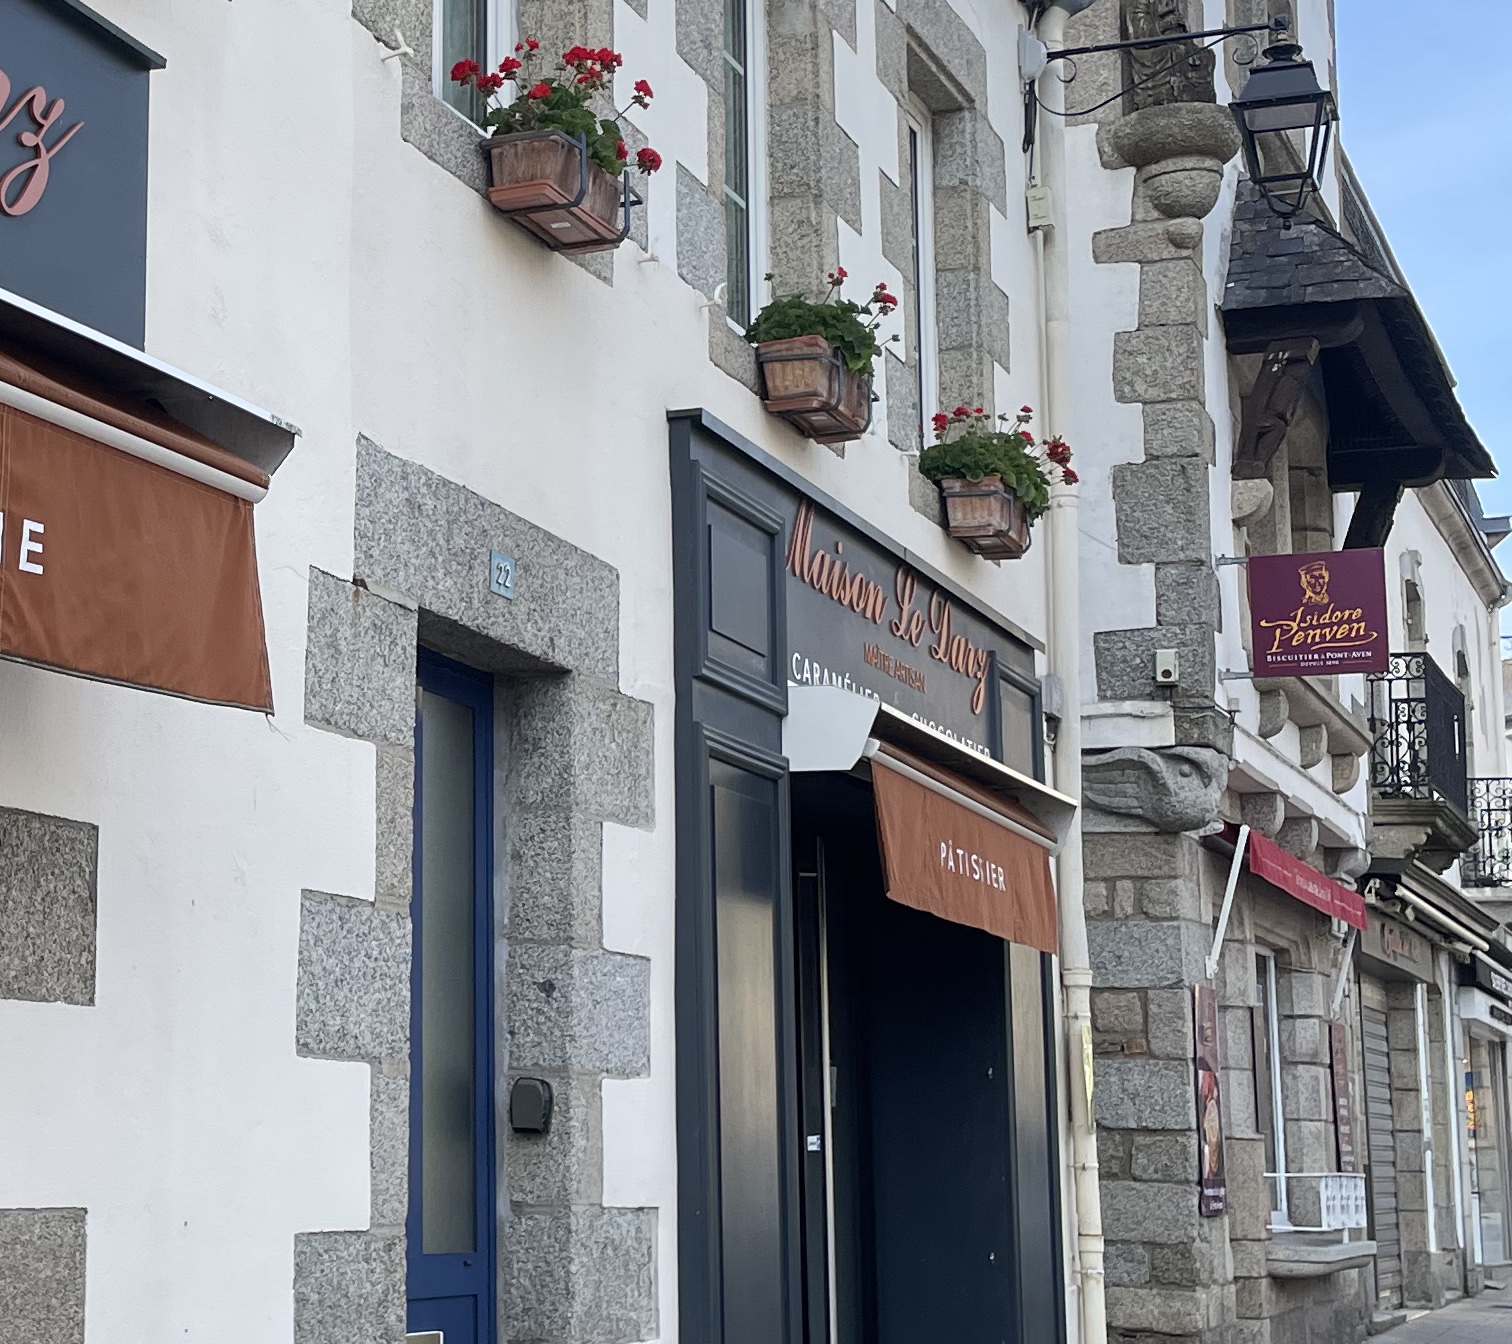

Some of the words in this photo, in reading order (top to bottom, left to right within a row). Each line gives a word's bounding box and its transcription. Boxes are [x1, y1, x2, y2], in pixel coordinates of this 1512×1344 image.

[496, 562, 511, 588] 22
[786, 499, 888, 624] Maison
[892, 567, 926, 646] Le
[930, 589, 988, 715] Darz
[1290, 603, 1362, 628] Isidore
[1260, 620, 1367, 654] Penven
